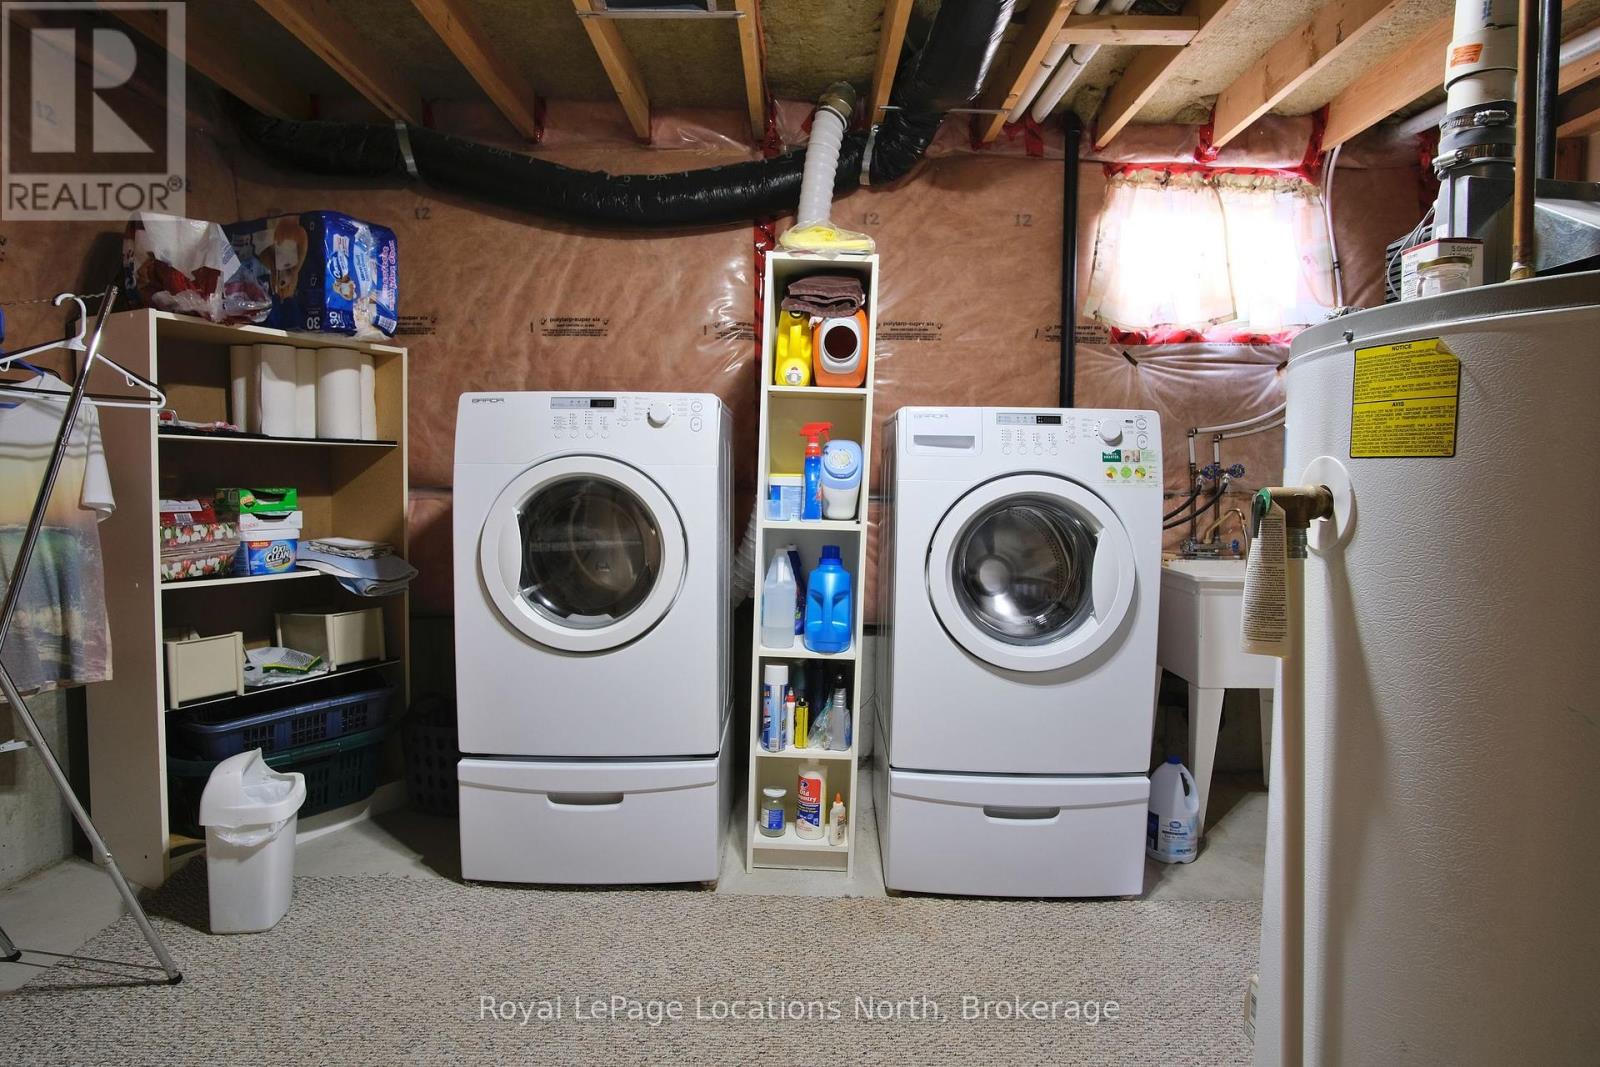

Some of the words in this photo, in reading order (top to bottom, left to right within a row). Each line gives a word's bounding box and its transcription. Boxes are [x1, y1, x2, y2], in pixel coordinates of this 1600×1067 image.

[863, 211, 880, 225] 12
[1013, 213, 1032, 228] 12
[1391, 343, 1412, 351] NOTICE
[272, 545, 287, 554] OXI
[265, 551, 290, 562] CLEAN
